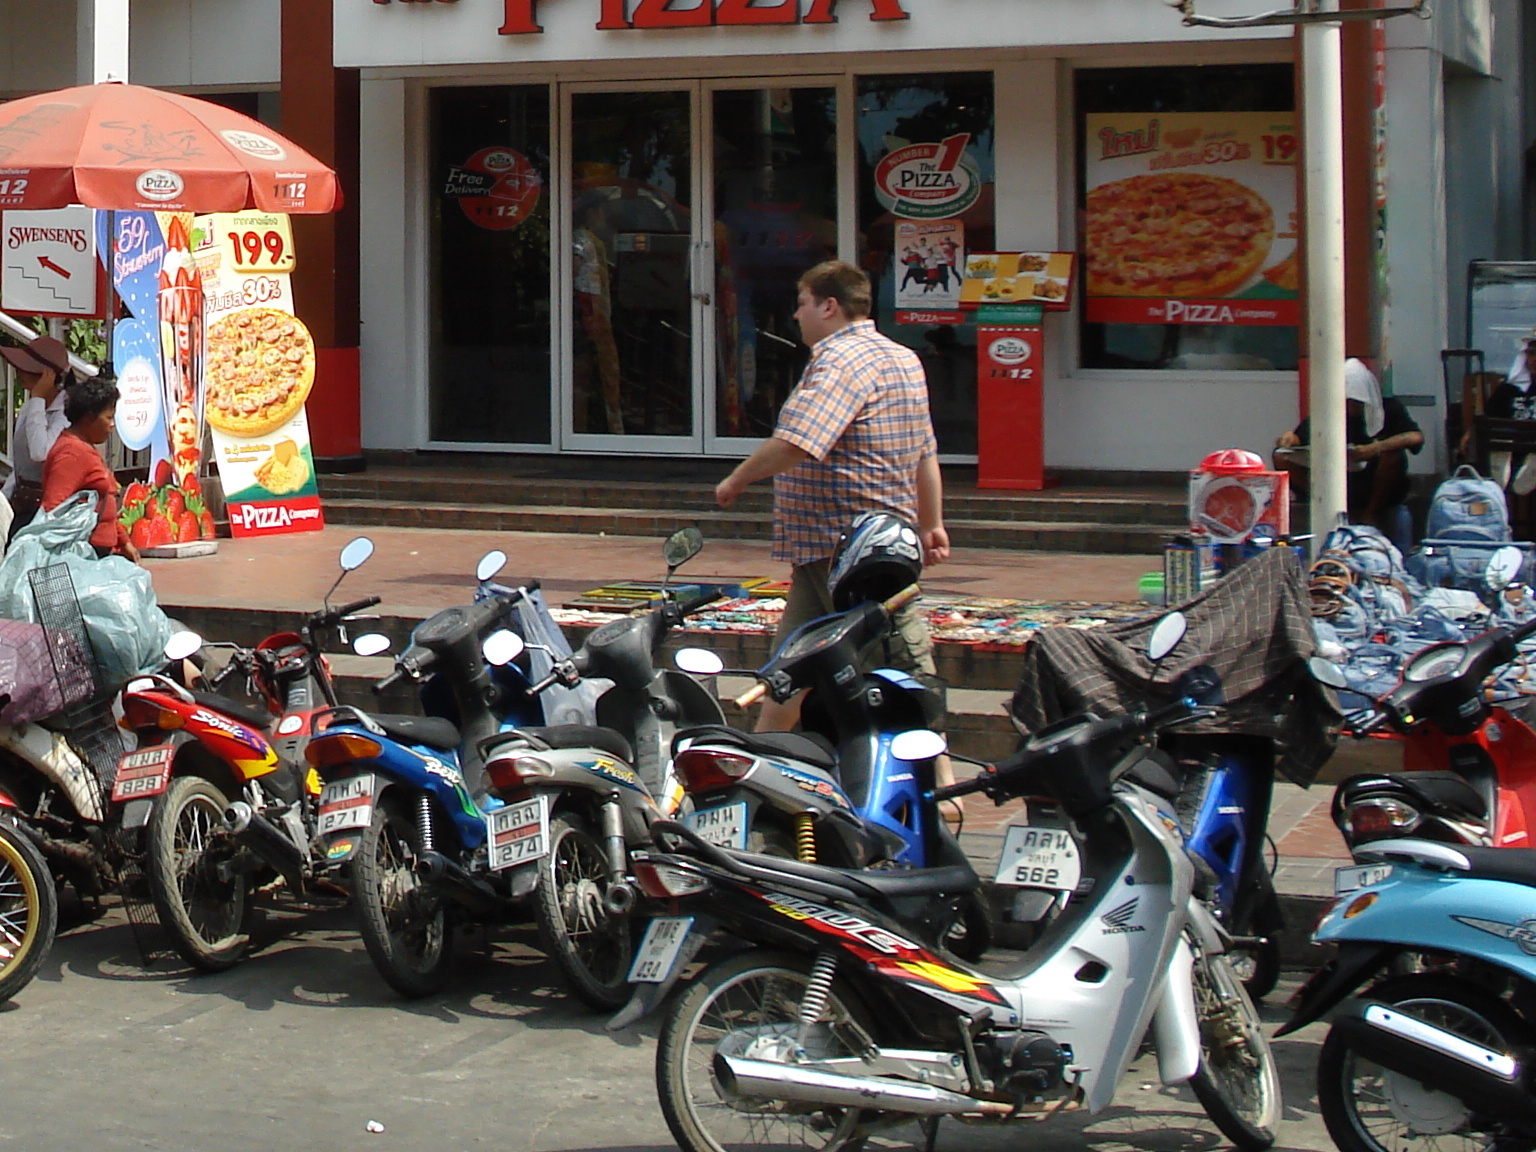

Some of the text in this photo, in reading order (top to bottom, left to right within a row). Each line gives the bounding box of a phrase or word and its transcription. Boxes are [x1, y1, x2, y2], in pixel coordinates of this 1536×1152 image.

[887, 148, 931, 165] NUMBER
[447, 167, 485, 186] Free
[919, 163, 937, 172] The
[146, 177, 177, 189] PIZZA
[900, 170, 955, 188] PIZZA
[273, 183, 306, 198] 1112
[444, 183, 490, 196] Delivery
[7, 226, 87, 253] SWENSEN'S
[243, 275, 282, 305] 30%
[1165, 299, 1234, 323] PIZZA
[997, 344, 1025, 355] PIZZA
[990, 368, 1034, 380] 1112
[240, 504, 292, 529] PIZZA
[190, 710, 244, 737] Sonic
[590, 758, 635, 784] Fresh
[122, 778, 157, 794] 828
[324, 810, 358, 829] 271
[501, 839, 538, 862] 274
[1015, 865, 1060, 885] 562
[1101, 925, 1147, 936] HONDA
